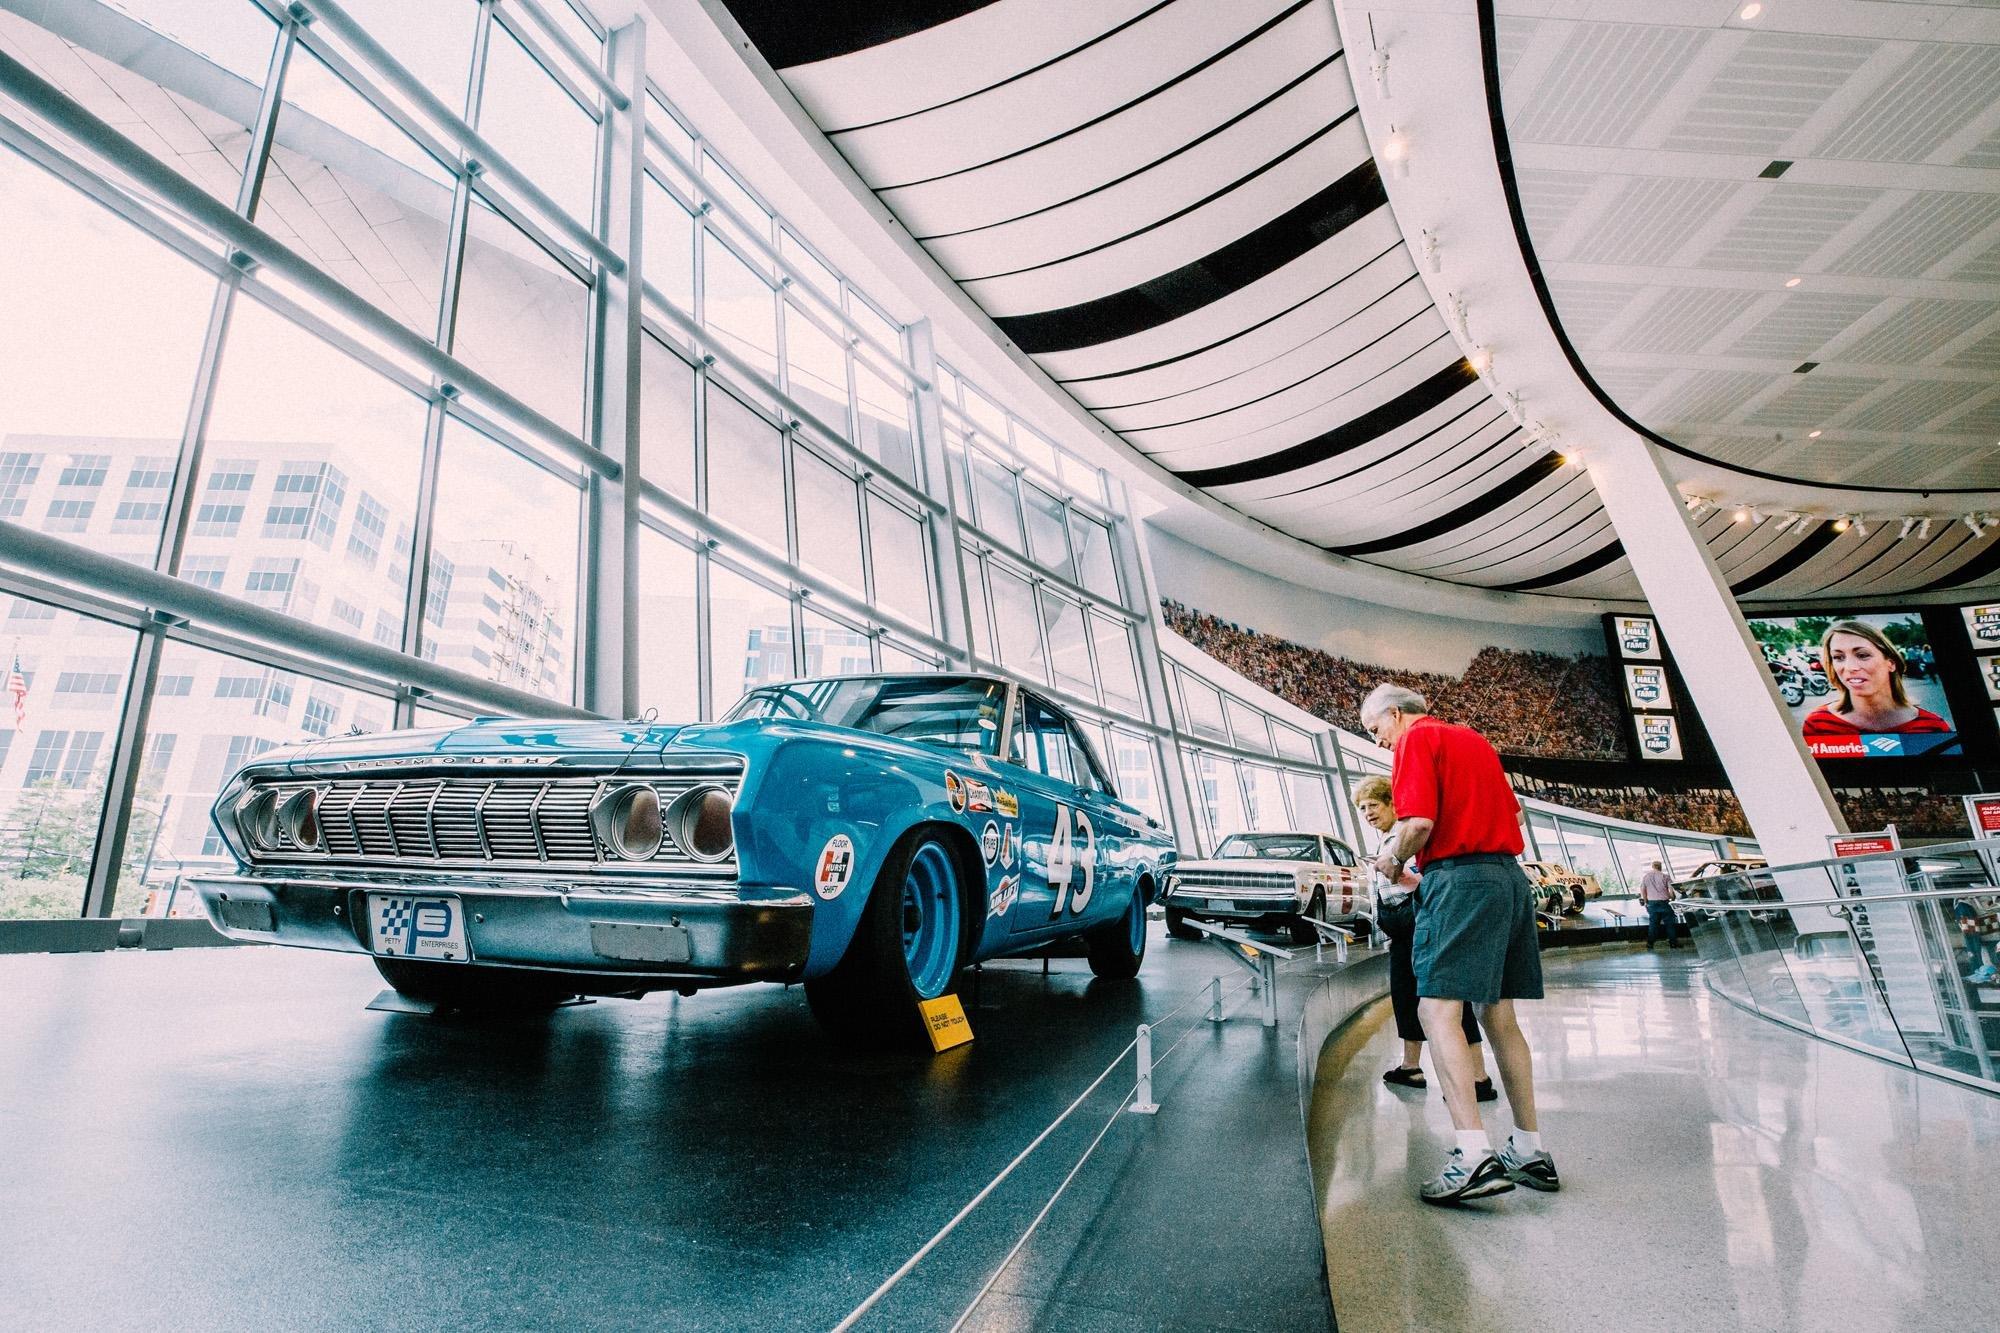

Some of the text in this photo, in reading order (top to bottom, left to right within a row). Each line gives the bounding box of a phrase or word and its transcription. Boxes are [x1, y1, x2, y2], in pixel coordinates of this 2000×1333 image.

[1980, 629, 2000, 638] FAM
[1820, 743, 1870, 754] America
[358, 758, 539, 768] PLYMOUTH
[832, 839, 849, 849] FLOOR
[1047, 804, 1096, 914] 43
[826, 863, 847, 873] HURST
[822, 885, 838, 894] SHIFT
[384, 937, 459, 950] PETTY ENTERPRISES
[930, 1013, 948, 1022] PLEASE
[941, 1020, 950, 1028] NOT
[950, 1016, 965, 1025] TOUCH
